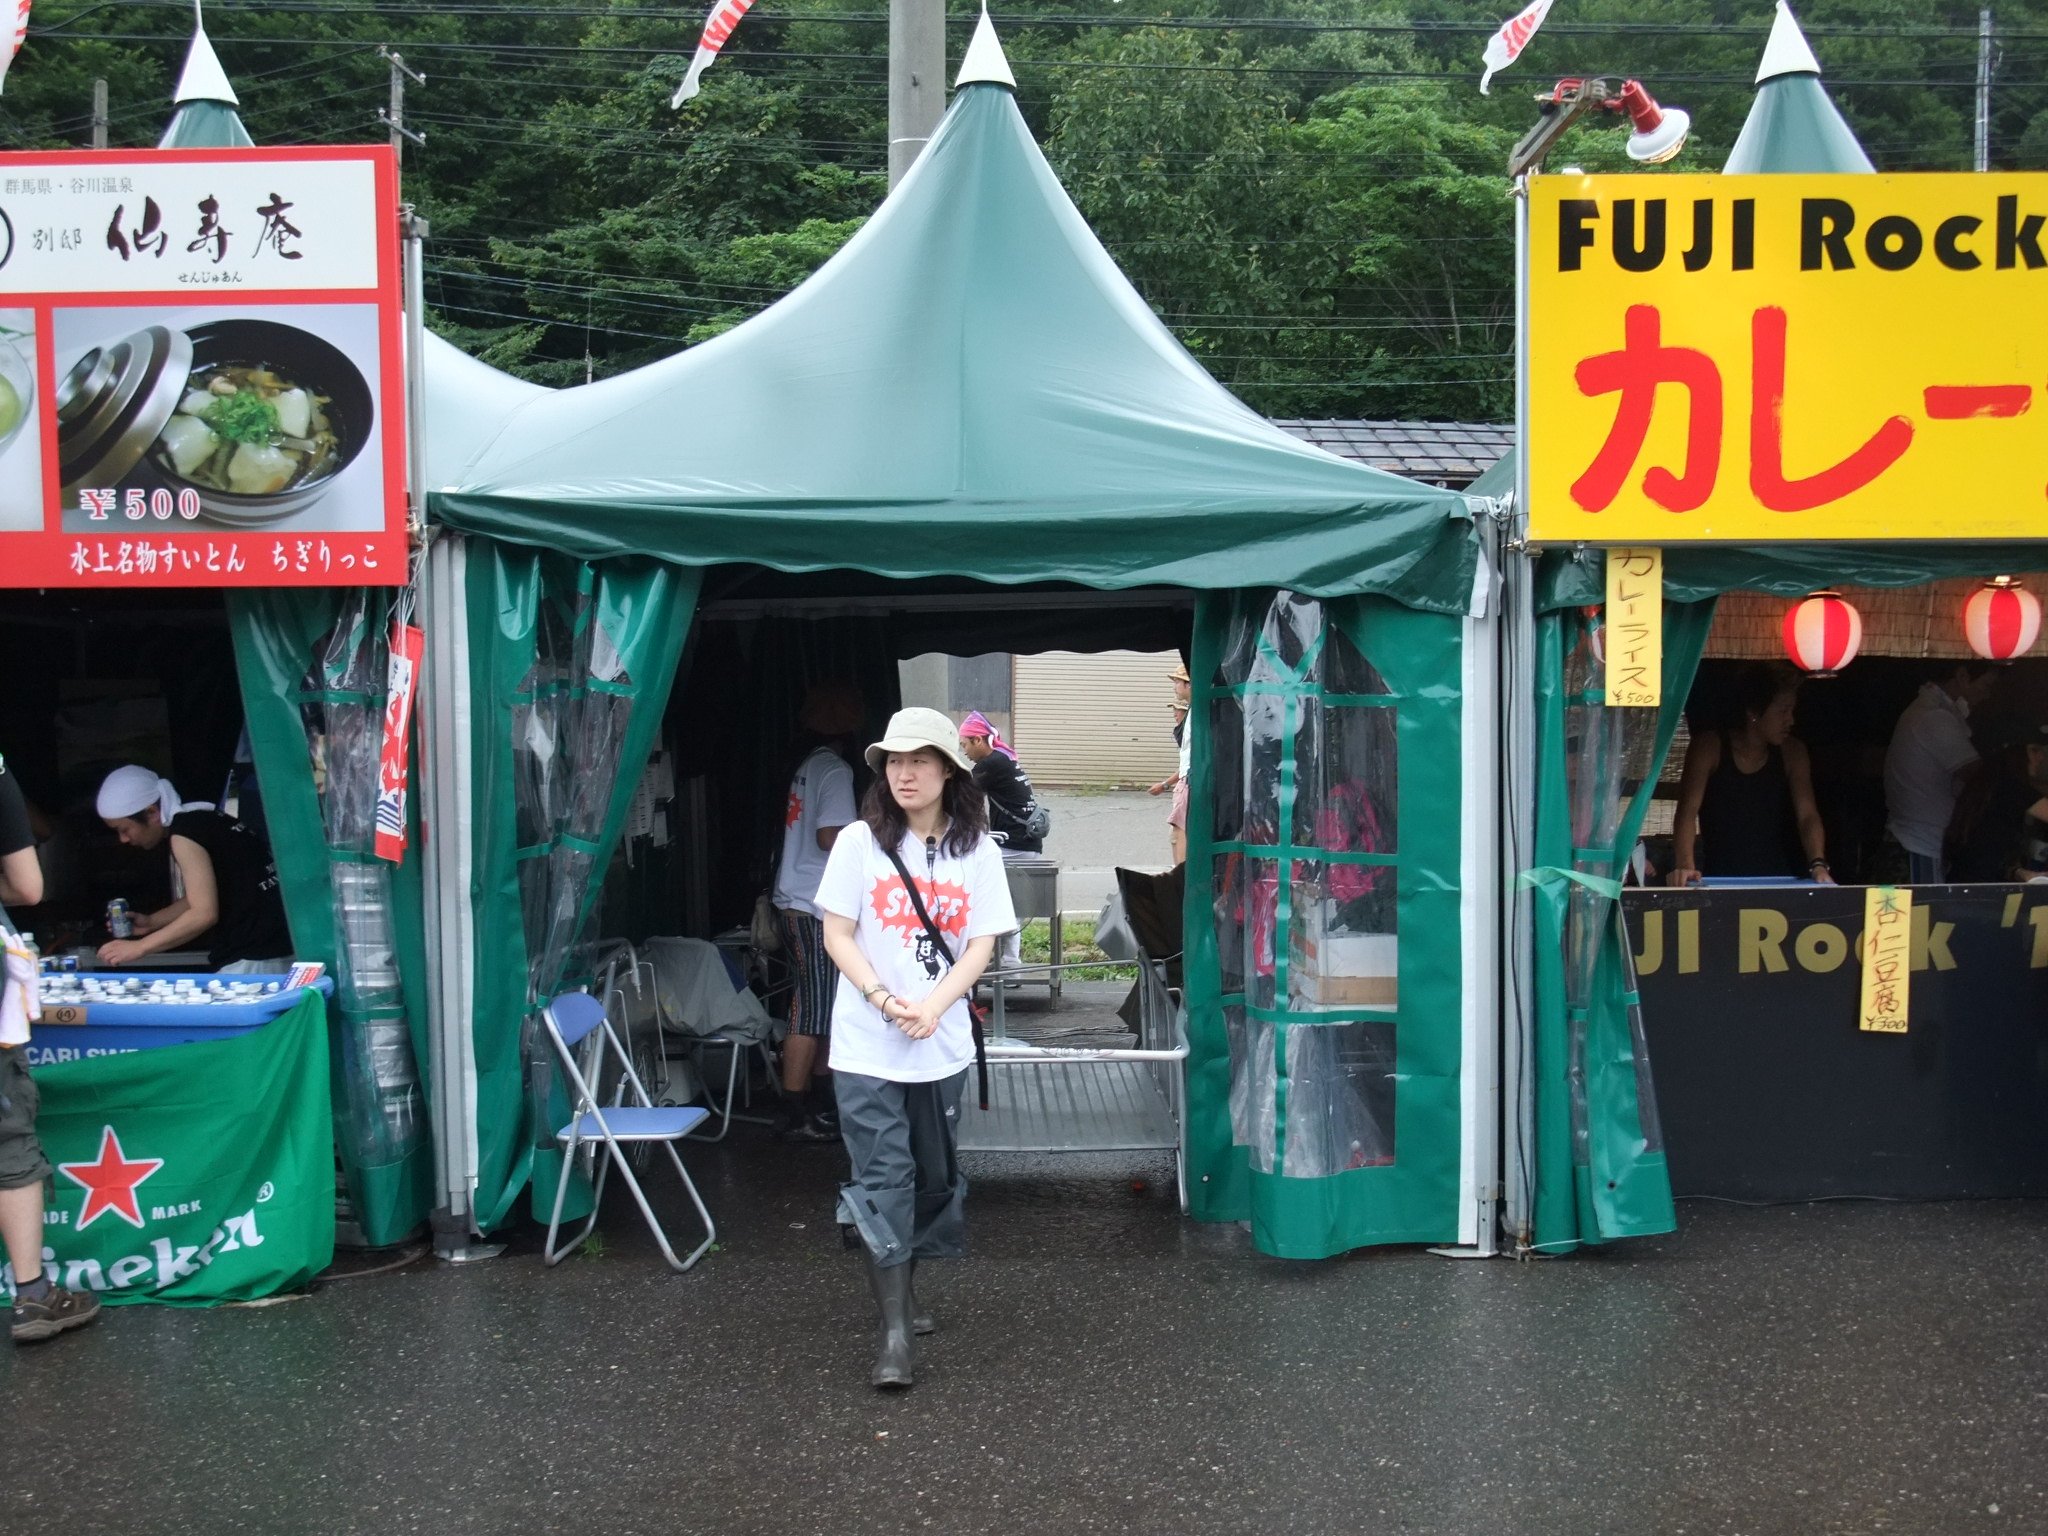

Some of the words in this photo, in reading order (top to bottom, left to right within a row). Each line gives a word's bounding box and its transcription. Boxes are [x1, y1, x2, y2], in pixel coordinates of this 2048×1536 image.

[5, 177, 134, 195] 群馬県・谷川温泉
[32, 226, 82, 252] 別邸
[1558, 198, 1755, 273] FUJI
[1800, 194, 2048, 272] Rock
[178, 271, 243, 283] せんじゅあん
[1569, 303, 2048, 514] カレー
[80, 488, 200, 520] ¥500
[70, 541, 246, 575] 水上名物すいとん
[272, 539, 379, 573] ちぎりっこ
[1612, 549, 1655, 688] カレーライス
[1738, 905, 1957, 974] Rok
[1866, 1015, 1906, 1030] ¥300
[152, 1200, 203, 1221] MARK
